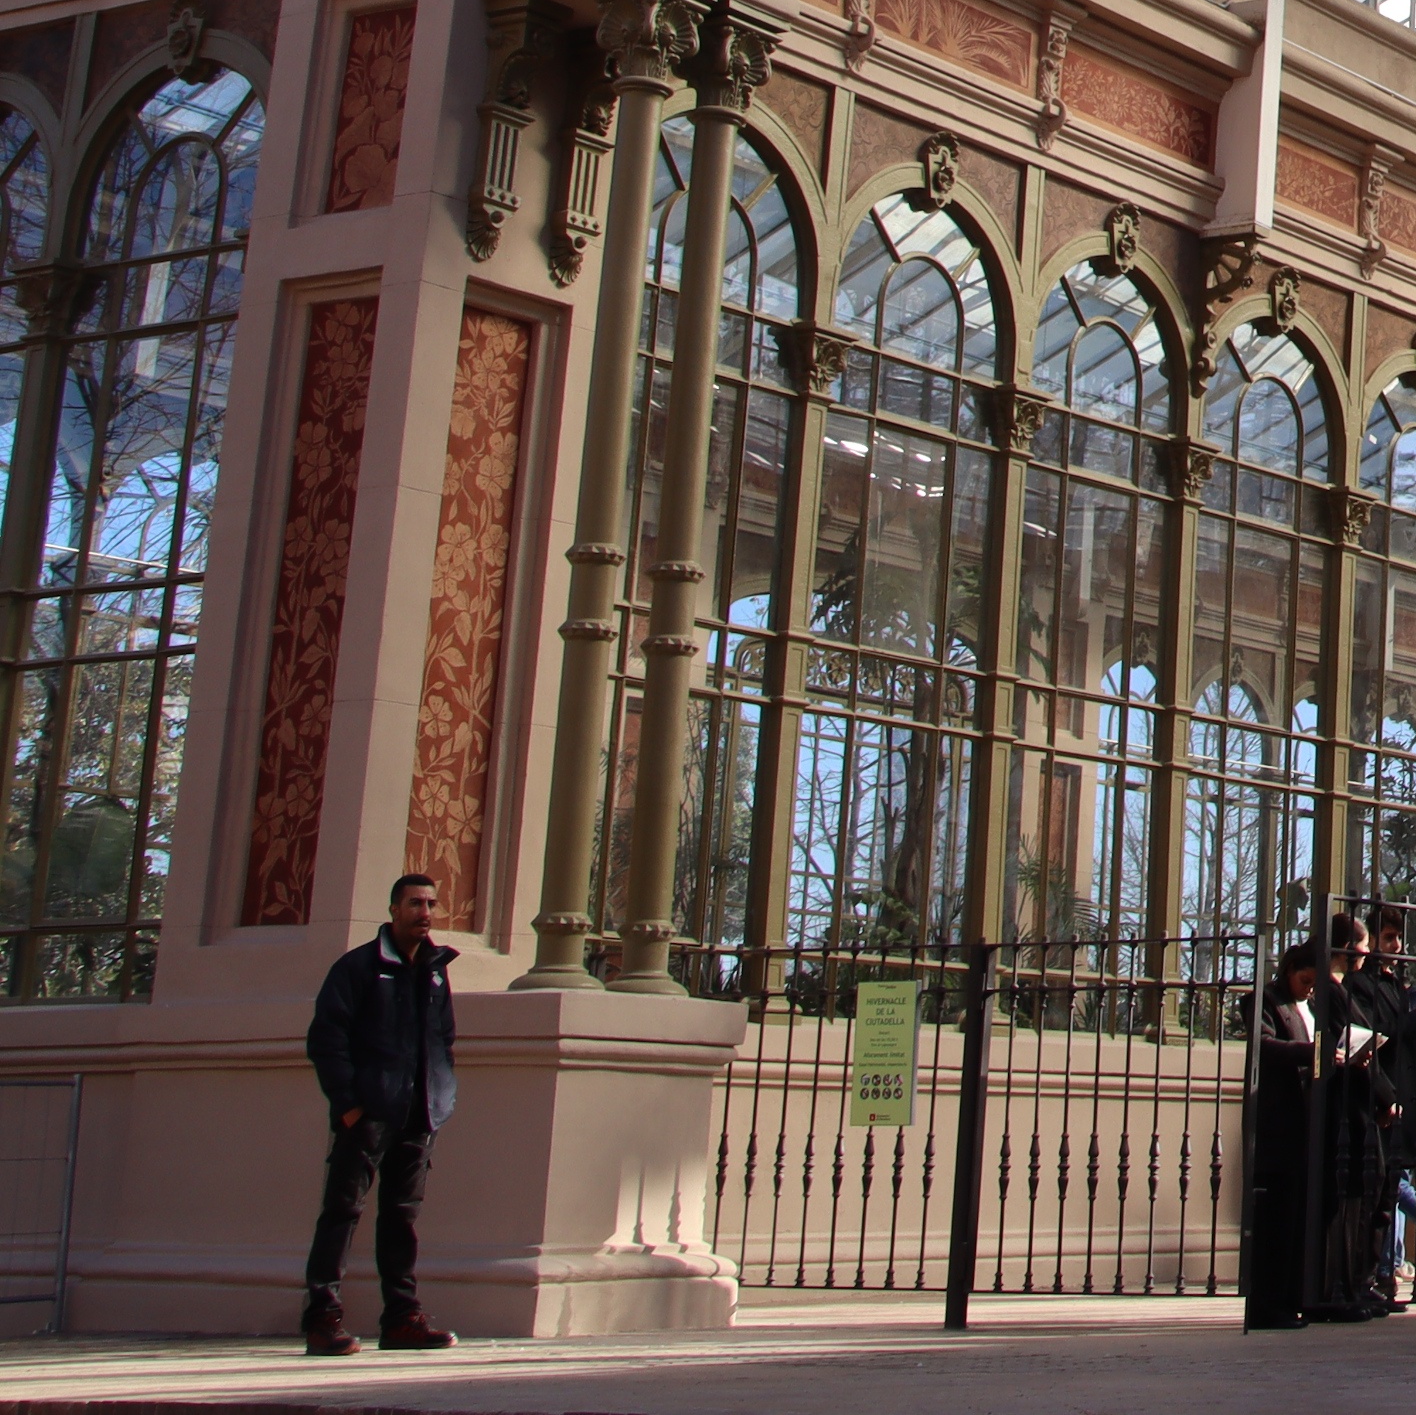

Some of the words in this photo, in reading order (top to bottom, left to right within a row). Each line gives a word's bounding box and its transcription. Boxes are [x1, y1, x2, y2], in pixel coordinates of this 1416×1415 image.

[866, 997, 906, 1006] HIVERNACLE
[876, 1008, 885, 1016] DE
[886, 1007, 895, 1015] LA
[865, 1017, 905, 1026] CIUTADELLA
